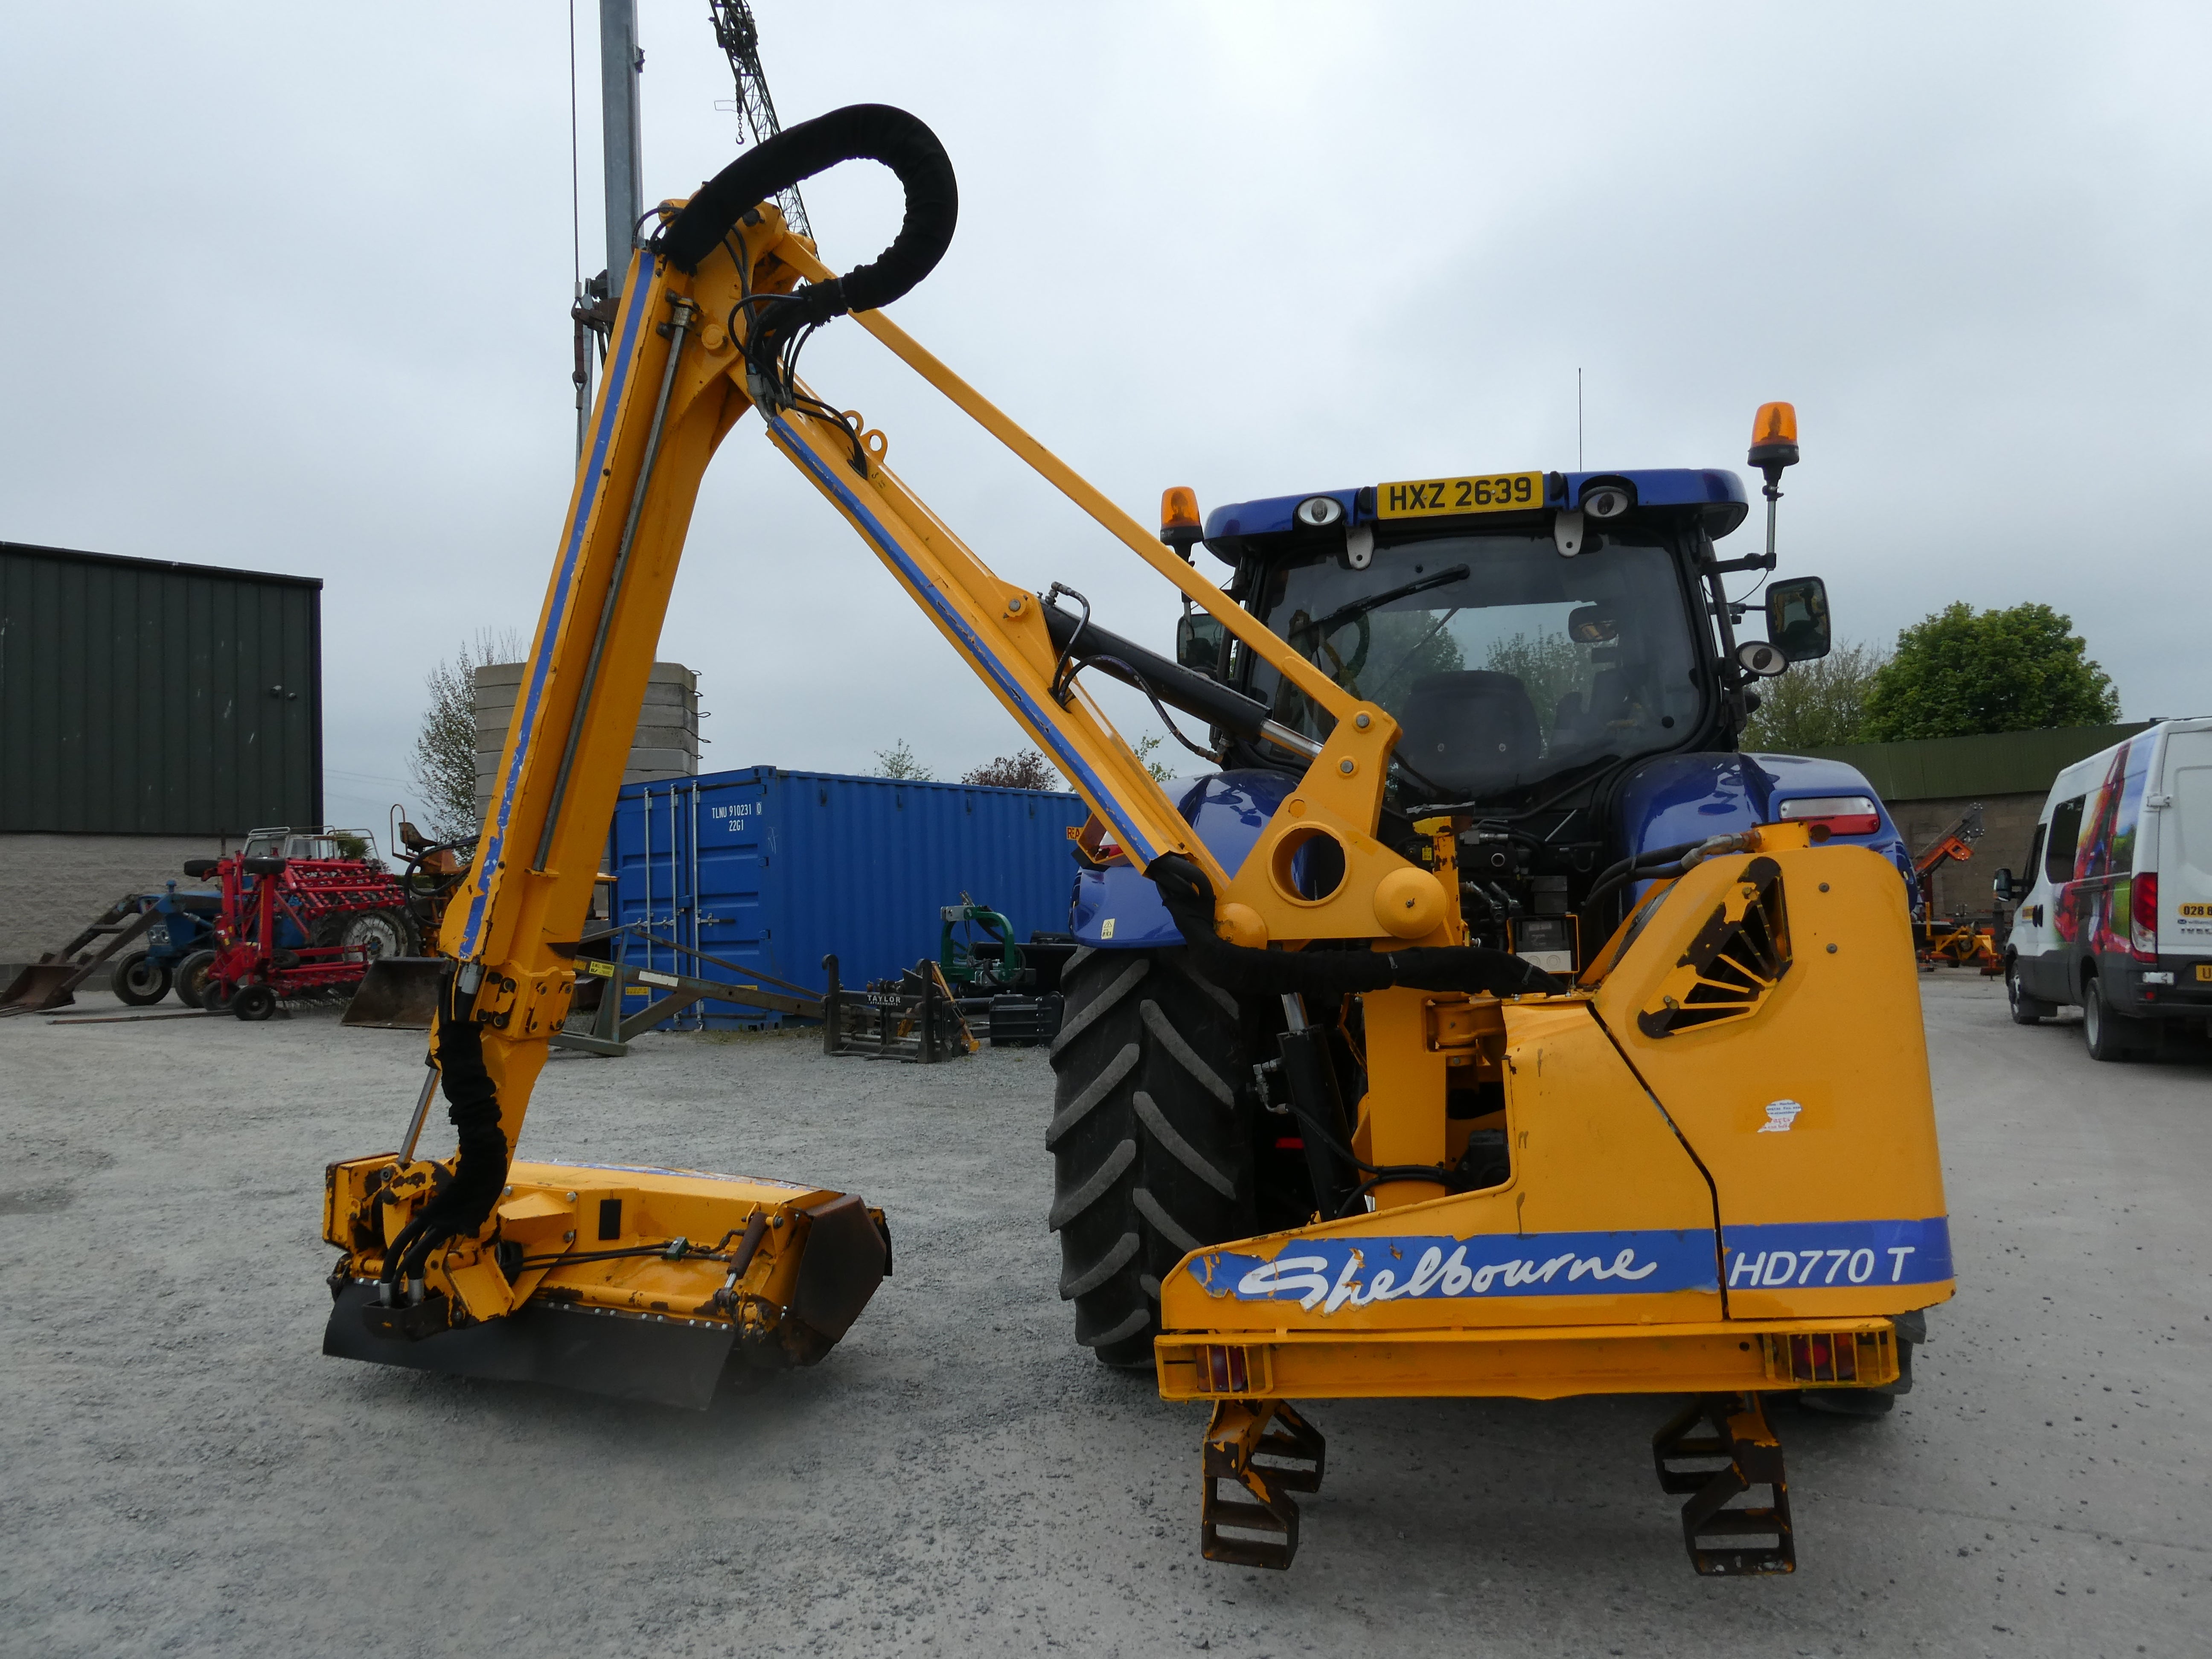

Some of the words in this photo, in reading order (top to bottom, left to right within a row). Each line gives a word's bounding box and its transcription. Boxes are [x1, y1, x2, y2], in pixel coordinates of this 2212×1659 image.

[1390, 483, 1445, 511] HXZ
[1455, 477, 1531, 507] 2639
[712, 806, 727, 818] TLNU
[729, 803, 751, 816] 910231
[729, 819, 744, 831] 22G1
[2183, 906, 2204, 915] 028
[1729, 1248, 1875, 1286] HD770
[1887, 1246, 1915, 1282] T
[1238, 1245, 1657, 1315] Shelbourne
